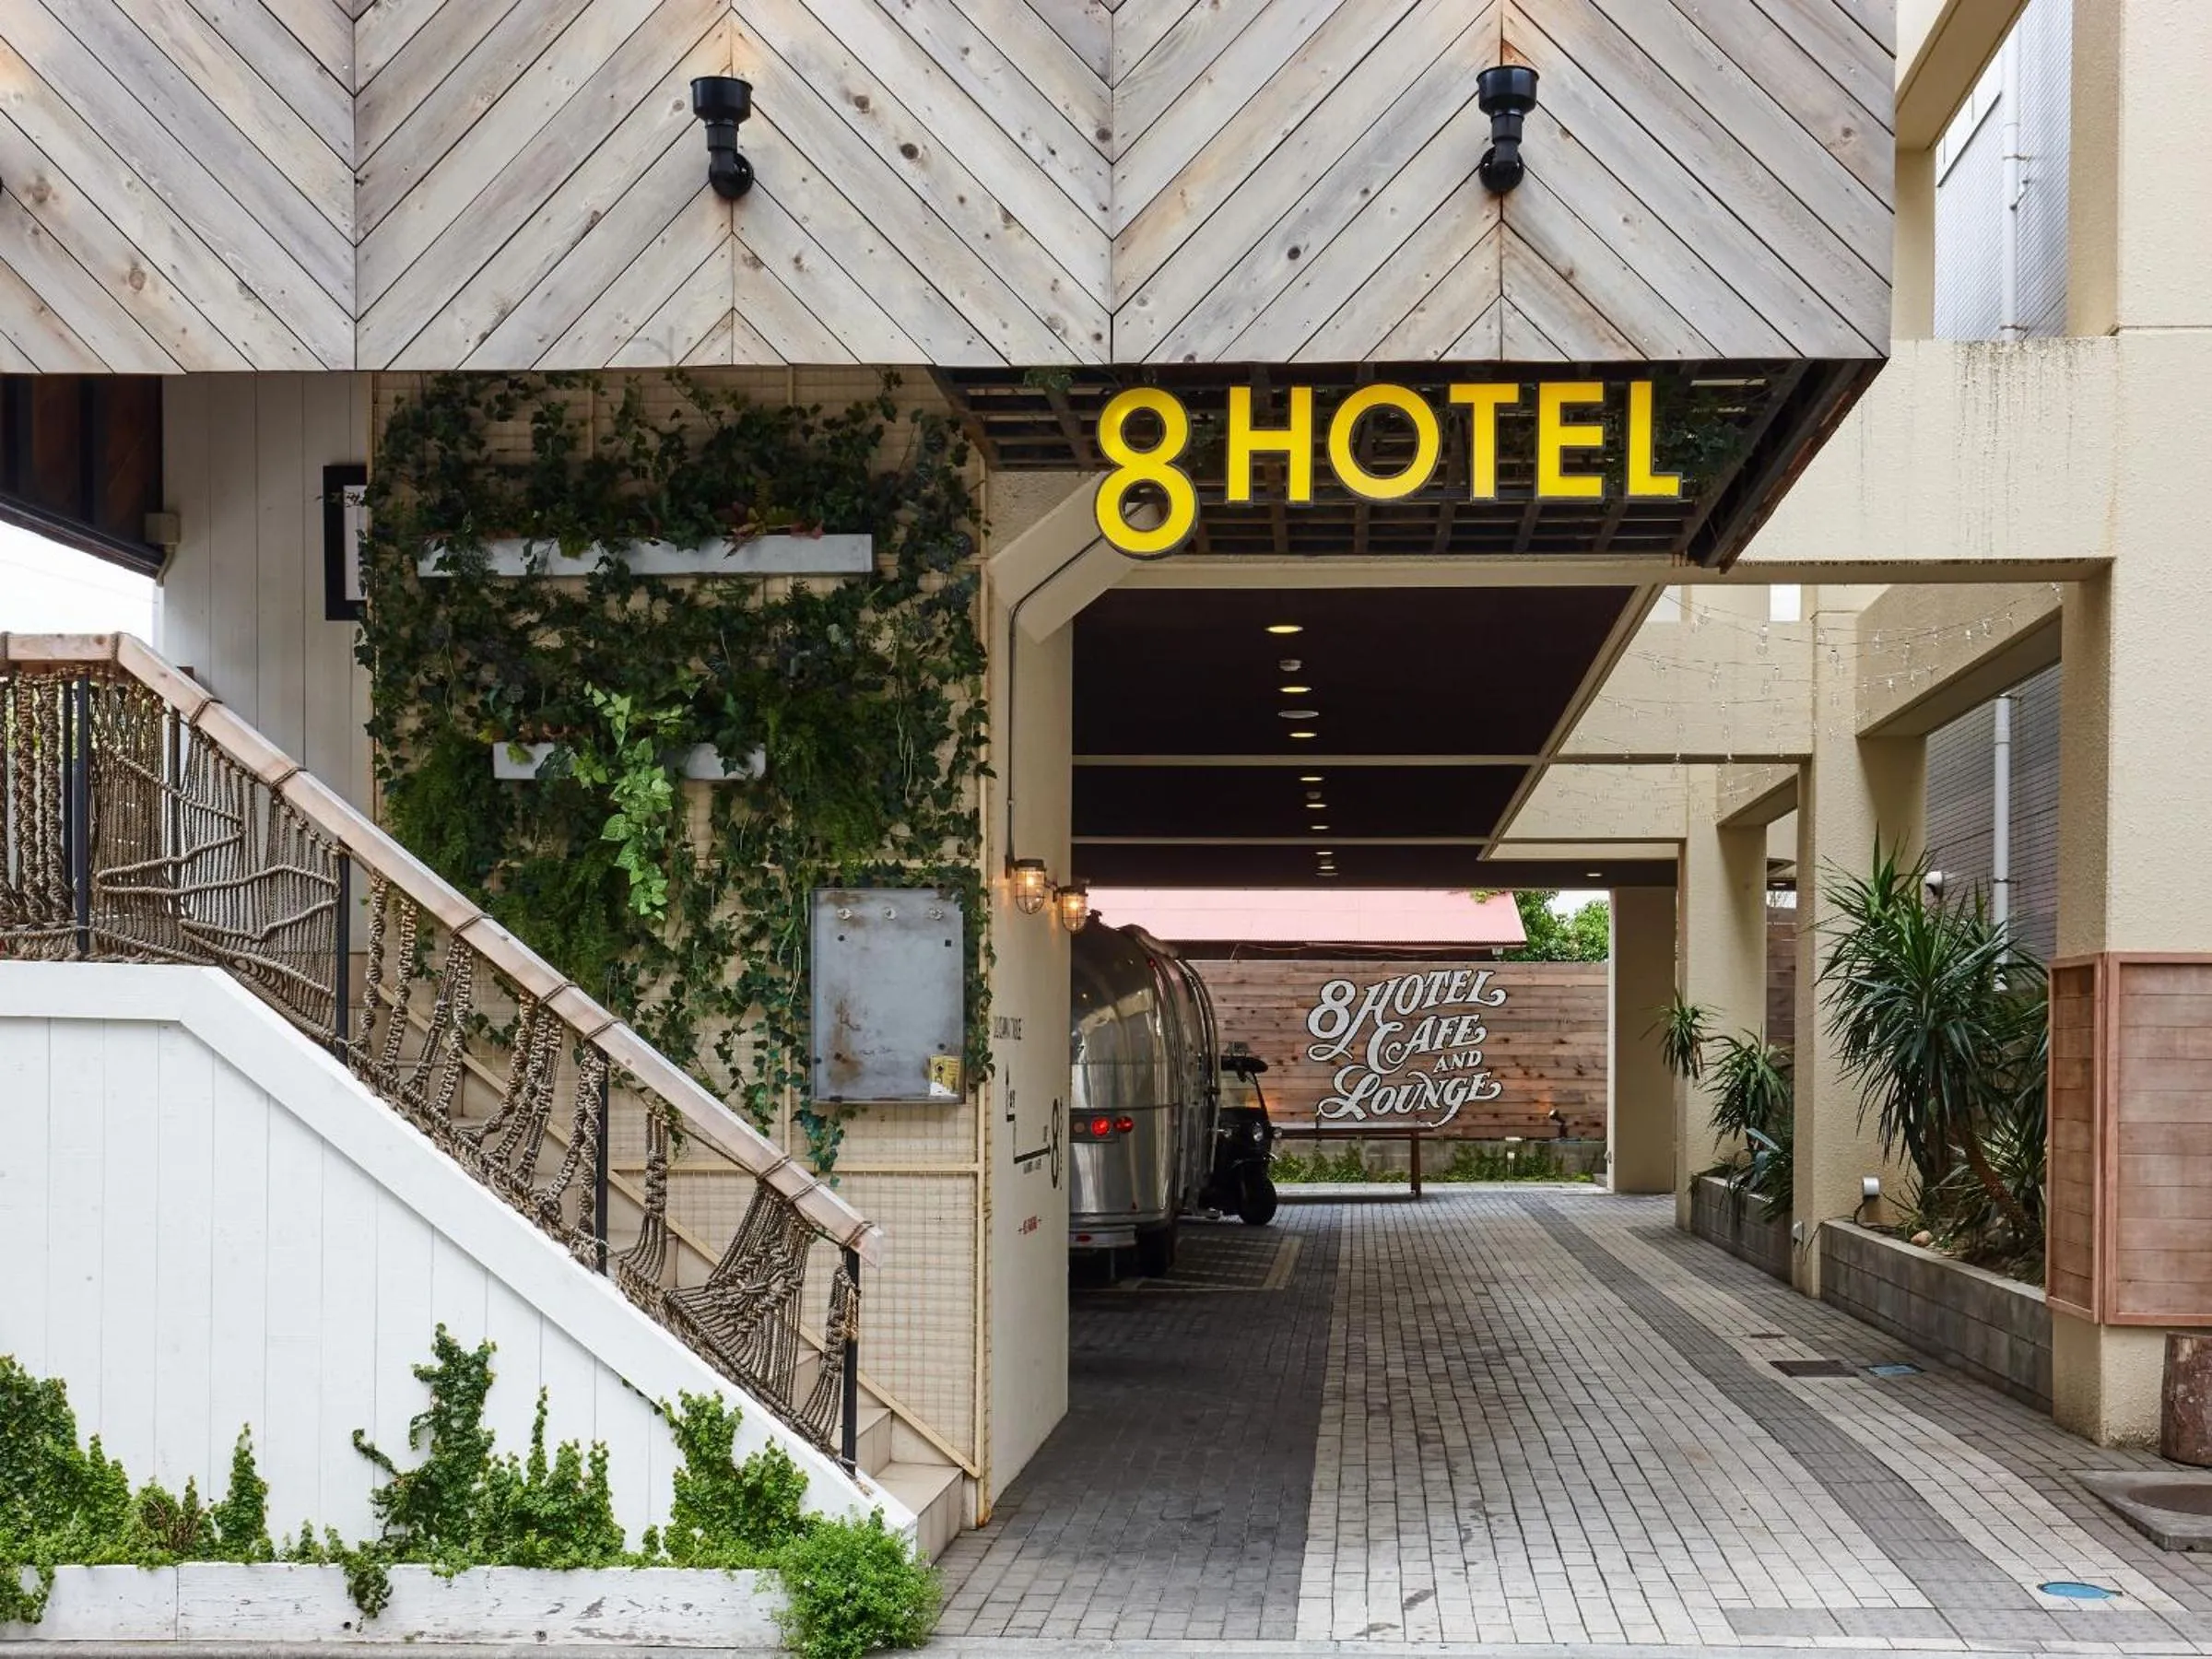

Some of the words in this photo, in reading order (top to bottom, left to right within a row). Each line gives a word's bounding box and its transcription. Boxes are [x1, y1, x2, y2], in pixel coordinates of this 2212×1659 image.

[1093, 384, 1199, 559] 8
[1225, 380, 1683, 504] HOTEL
[1307, 979, 1358, 1041] 8
[1307, 970, 1508, 1062] HOTEL
[1366, 1013, 1488, 1075] CAFE
[1432, 1050, 1484, 1074] AND
[1316, 1065, 1503, 1128] LOUNGE
